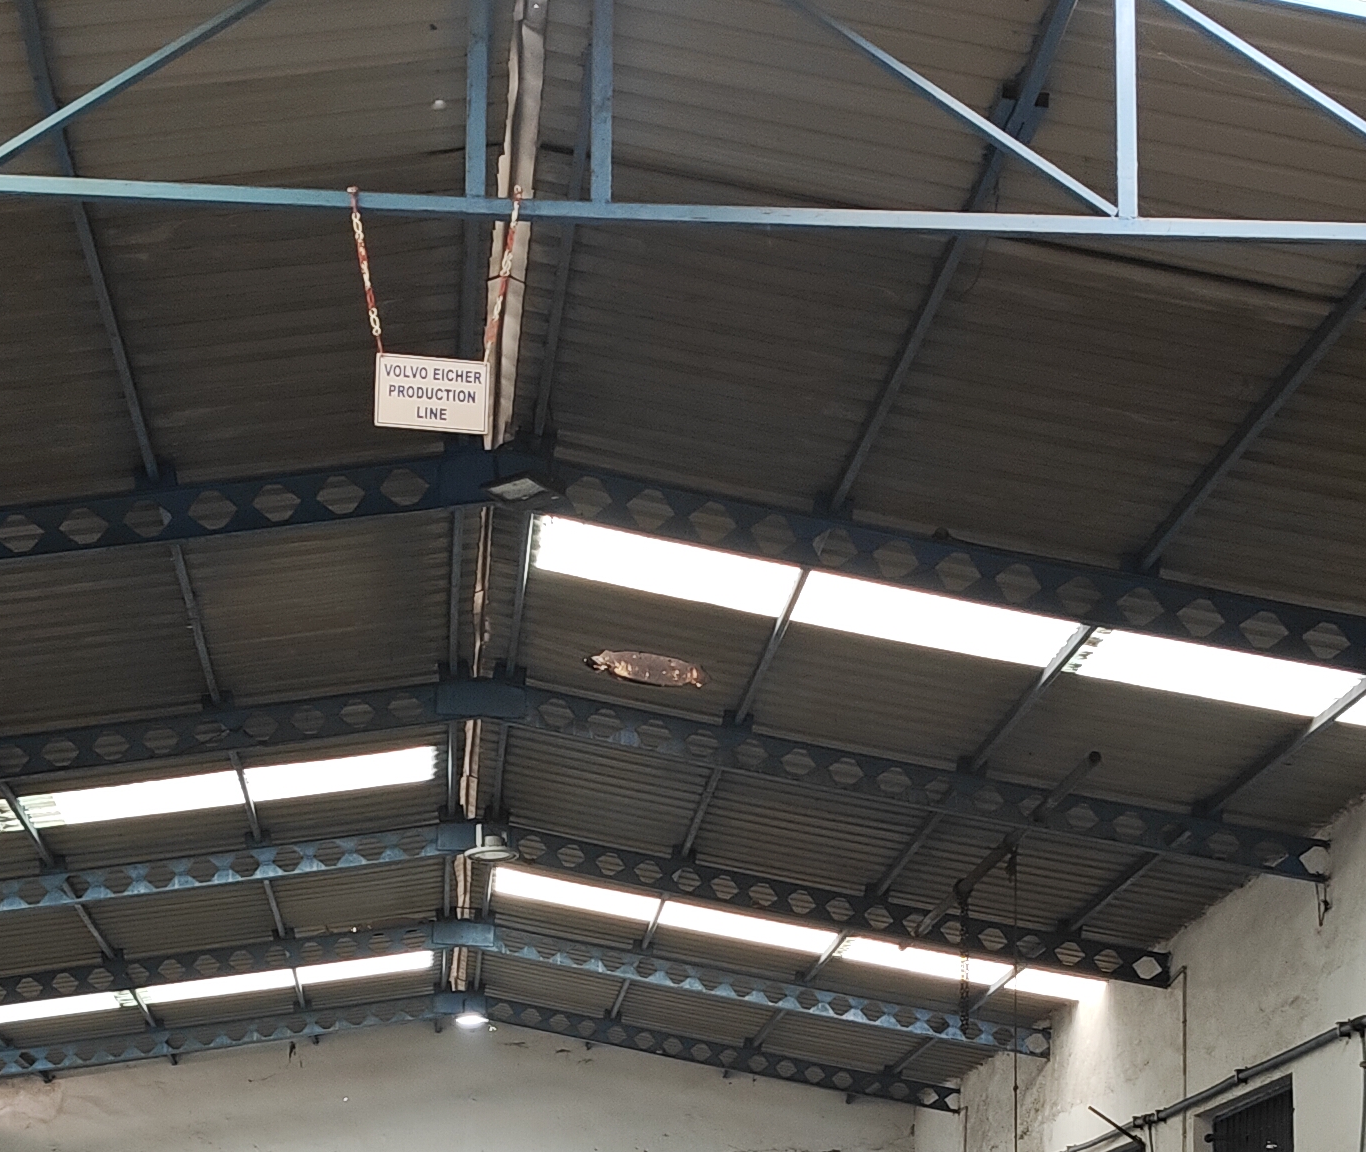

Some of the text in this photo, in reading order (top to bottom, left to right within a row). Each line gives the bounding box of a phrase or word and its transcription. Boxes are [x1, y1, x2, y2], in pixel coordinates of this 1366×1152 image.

[385, 364, 482, 384] VOLVO EICHER
[388, 384, 476, 403] PRODUCTION
[417, 406, 447, 420] LINE
